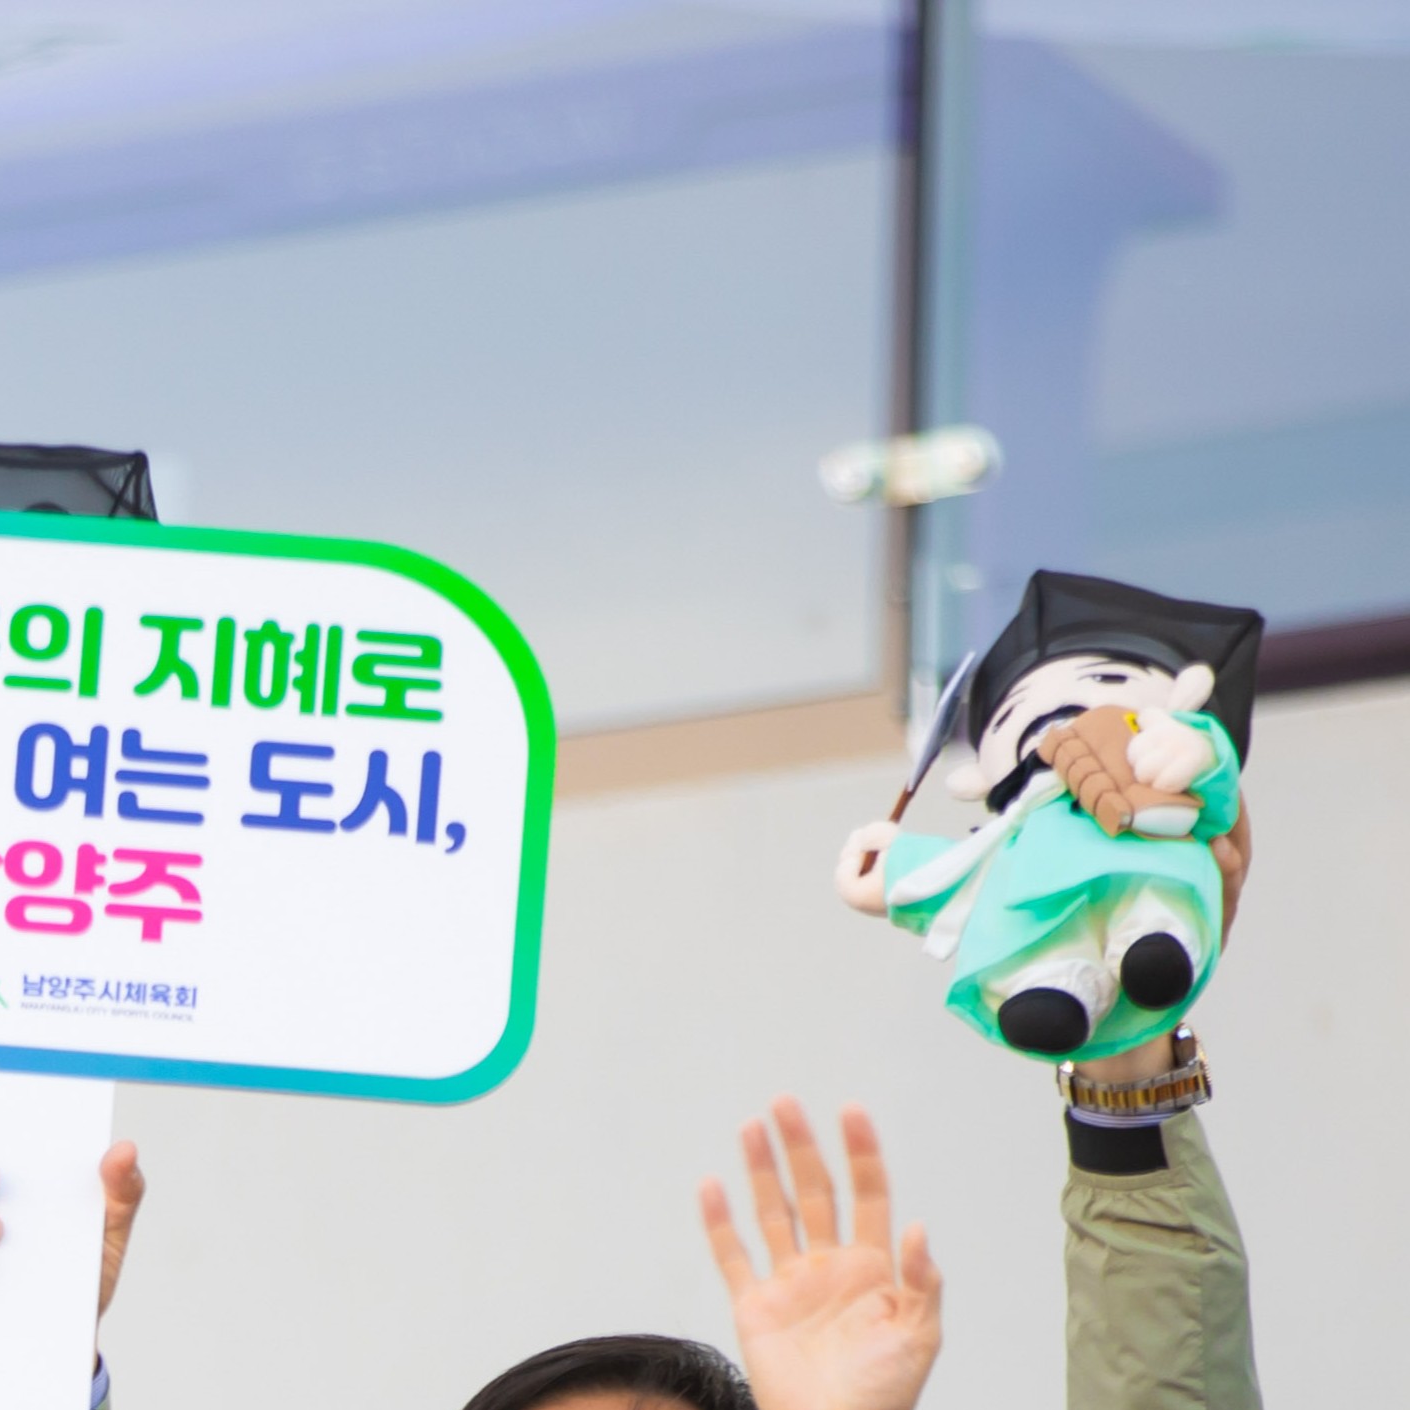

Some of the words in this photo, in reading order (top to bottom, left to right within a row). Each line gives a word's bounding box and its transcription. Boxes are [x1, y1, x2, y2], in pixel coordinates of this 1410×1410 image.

[133, 614, 445, 723] 지혜로
[13, 722, 211, 827] 여는
[240, 740, 468, 855] 도시,
[22, 973, 199, 1009] 남양주시체육회
